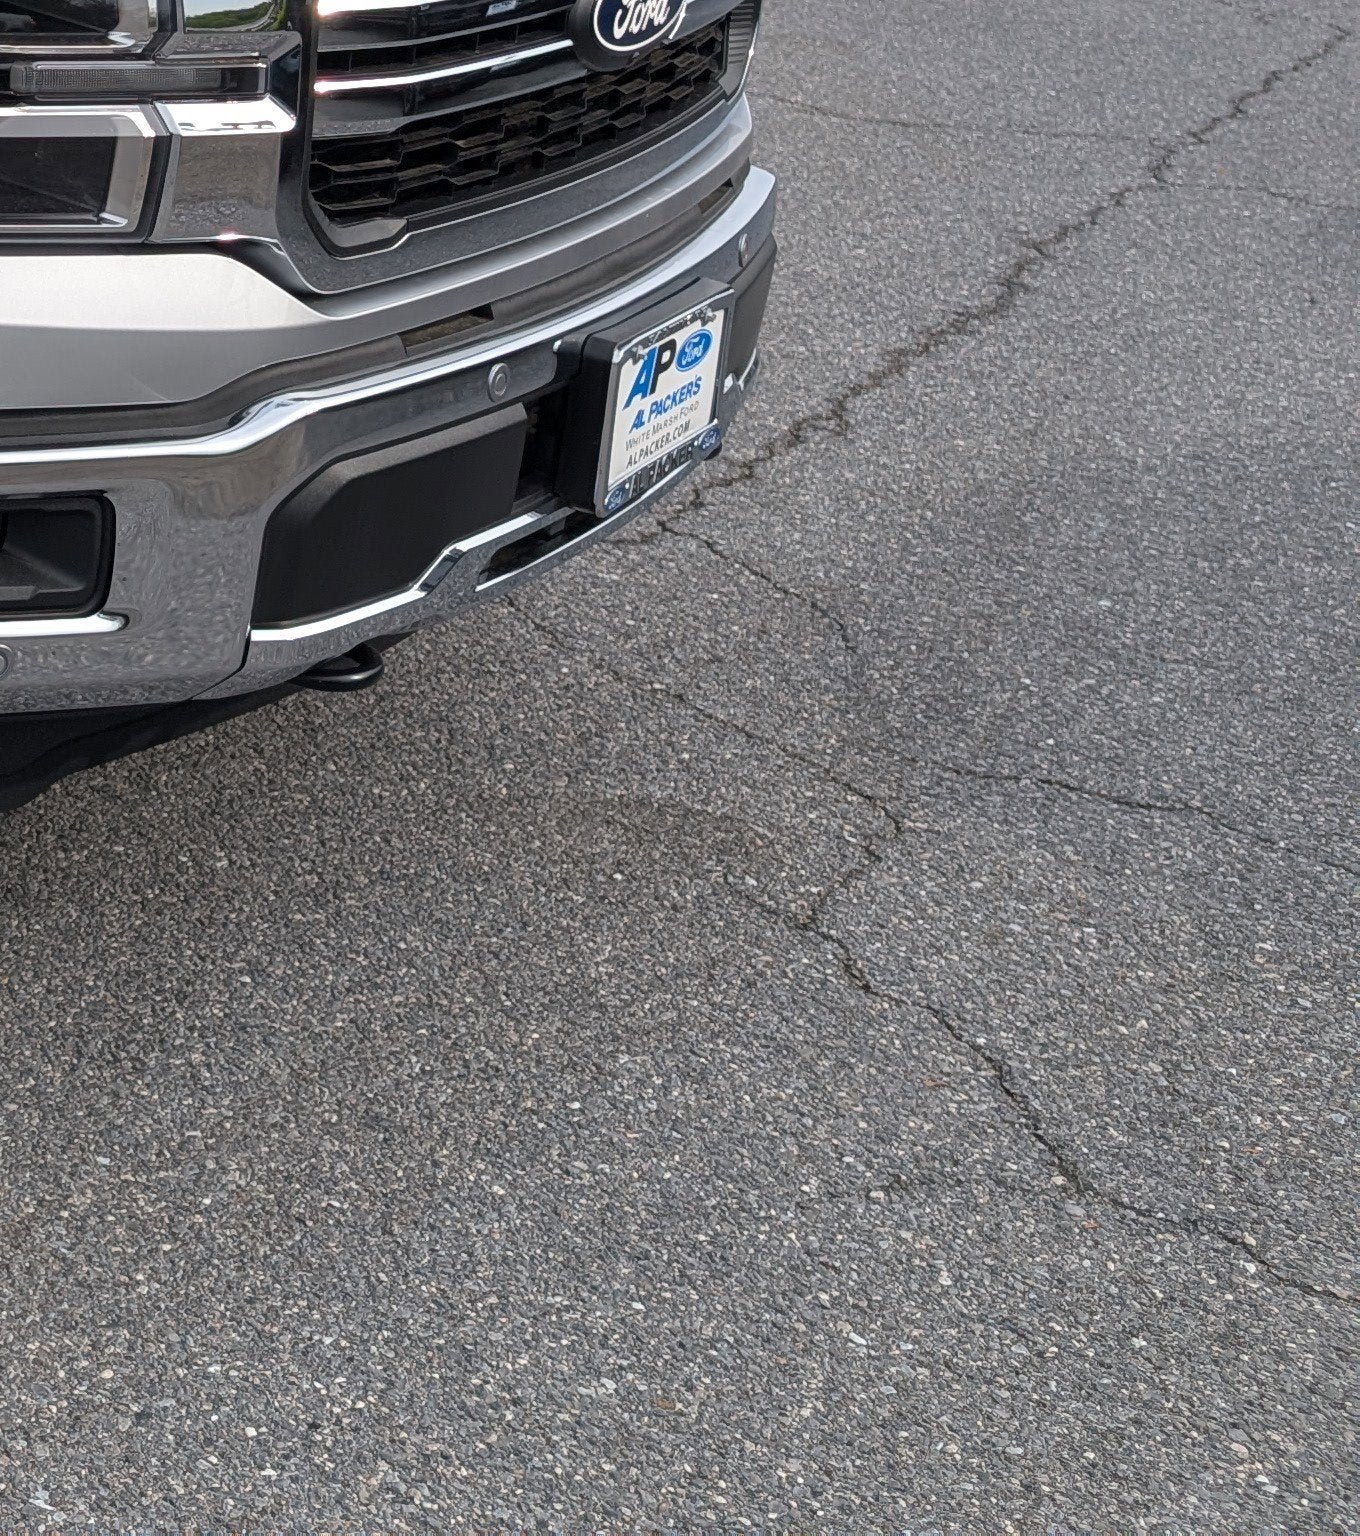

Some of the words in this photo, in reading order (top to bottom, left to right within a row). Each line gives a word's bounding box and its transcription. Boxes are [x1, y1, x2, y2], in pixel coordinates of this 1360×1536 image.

[623, 338, 677, 411] AP
[680, 335, 706, 367] Ford
[629, 408, 646, 434] AL
[647, 374, 702, 424] PACKER'S
[626, 419, 691, 470] ALPACKER.COM
